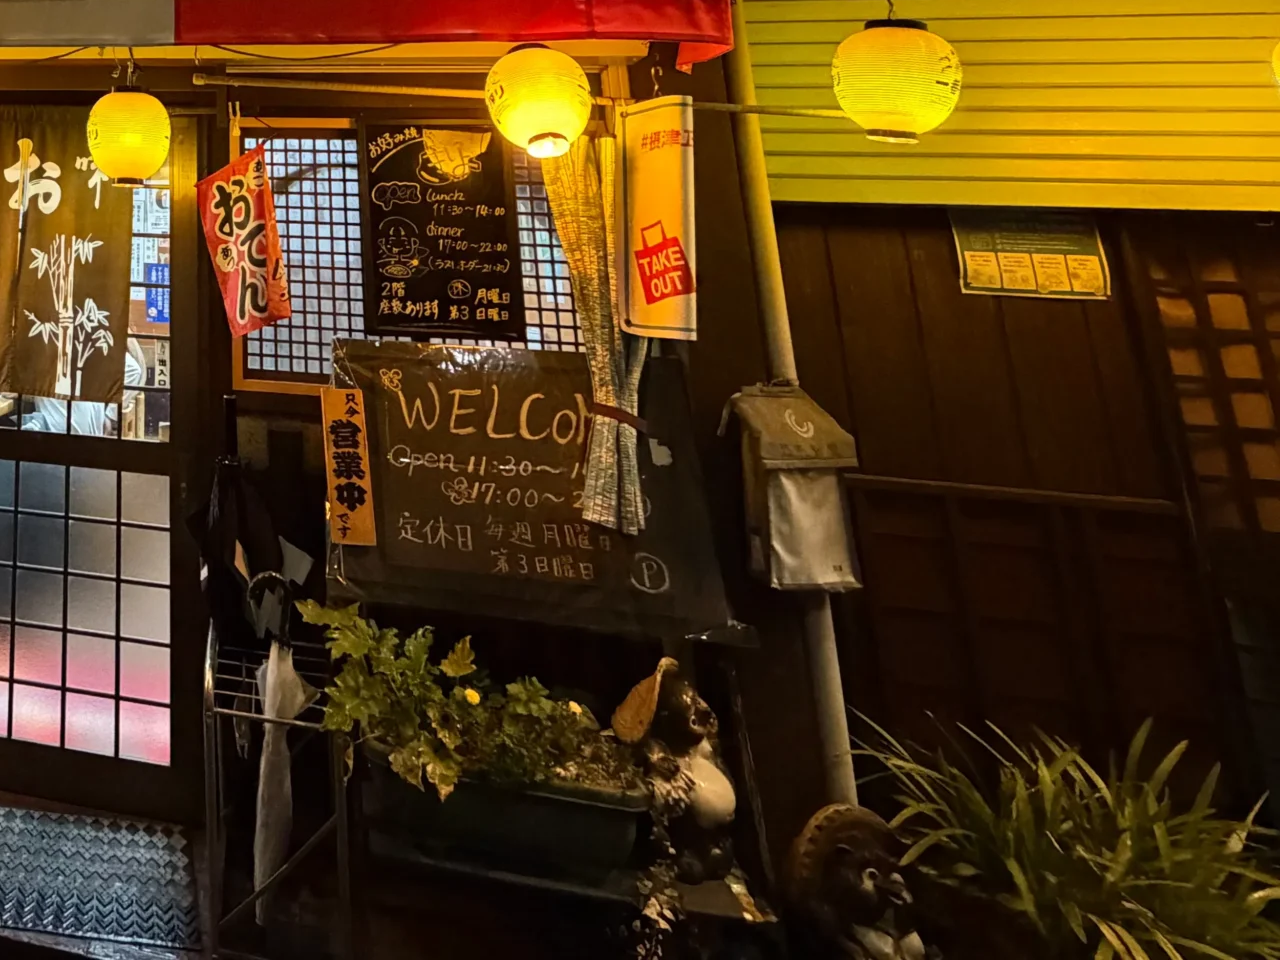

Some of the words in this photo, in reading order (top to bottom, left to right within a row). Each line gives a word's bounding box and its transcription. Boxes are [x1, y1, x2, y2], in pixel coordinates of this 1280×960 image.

[638, 246, 685, 276] TAKE
[474, 288, 510, 306] 月曜日
[651, 271, 682, 297] OUT
[389, 445, 459, 477] Open
[467, 455, 587, 480] 11:30～1
[397, 512, 473, 552] 定休日
